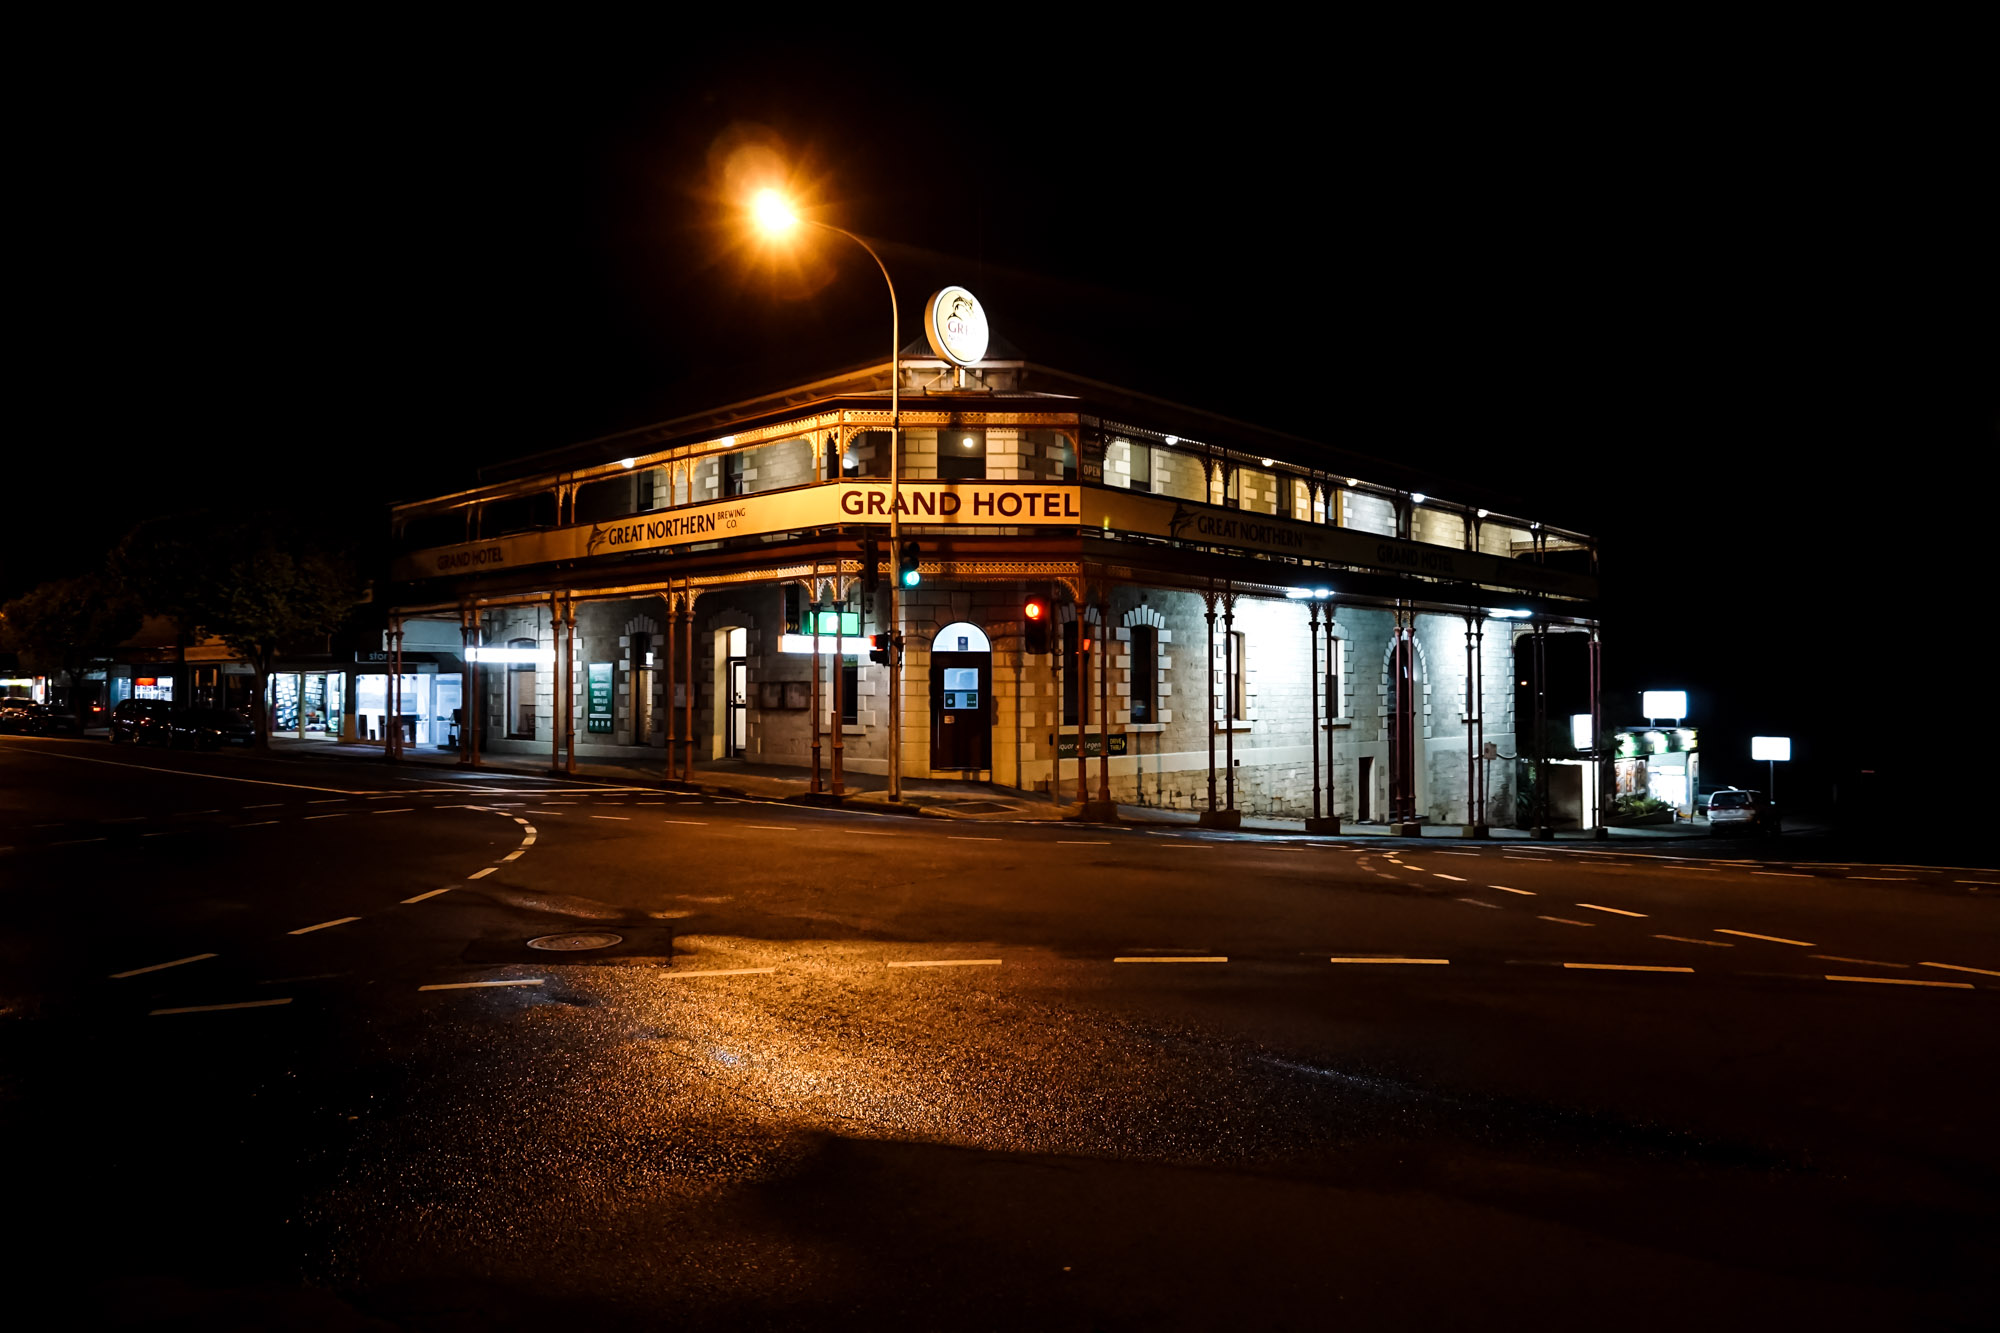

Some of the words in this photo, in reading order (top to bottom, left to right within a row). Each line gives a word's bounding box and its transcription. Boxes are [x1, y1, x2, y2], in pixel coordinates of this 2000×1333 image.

[1083, 465, 1101, 477] OPEN
[841, 491, 961, 515] GRAND
[973, 492, 1080, 517] HOTEL
[608, 523, 645, 545] GREAT
[647, 513, 716, 540] NORTHERN
[717, 508, 746, 520] BREWING
[1198, 516, 1238, 538] GREAT
[1240, 521, 1303, 547] NORTHERN
[438, 551, 470, 570] GRAND
[472, 546, 504, 566] HOTEL
[1377, 544, 1418, 566] GRAND
[1421, 549, 1456, 572] HOTEL
[1058, 743, 1074, 751] iquor
